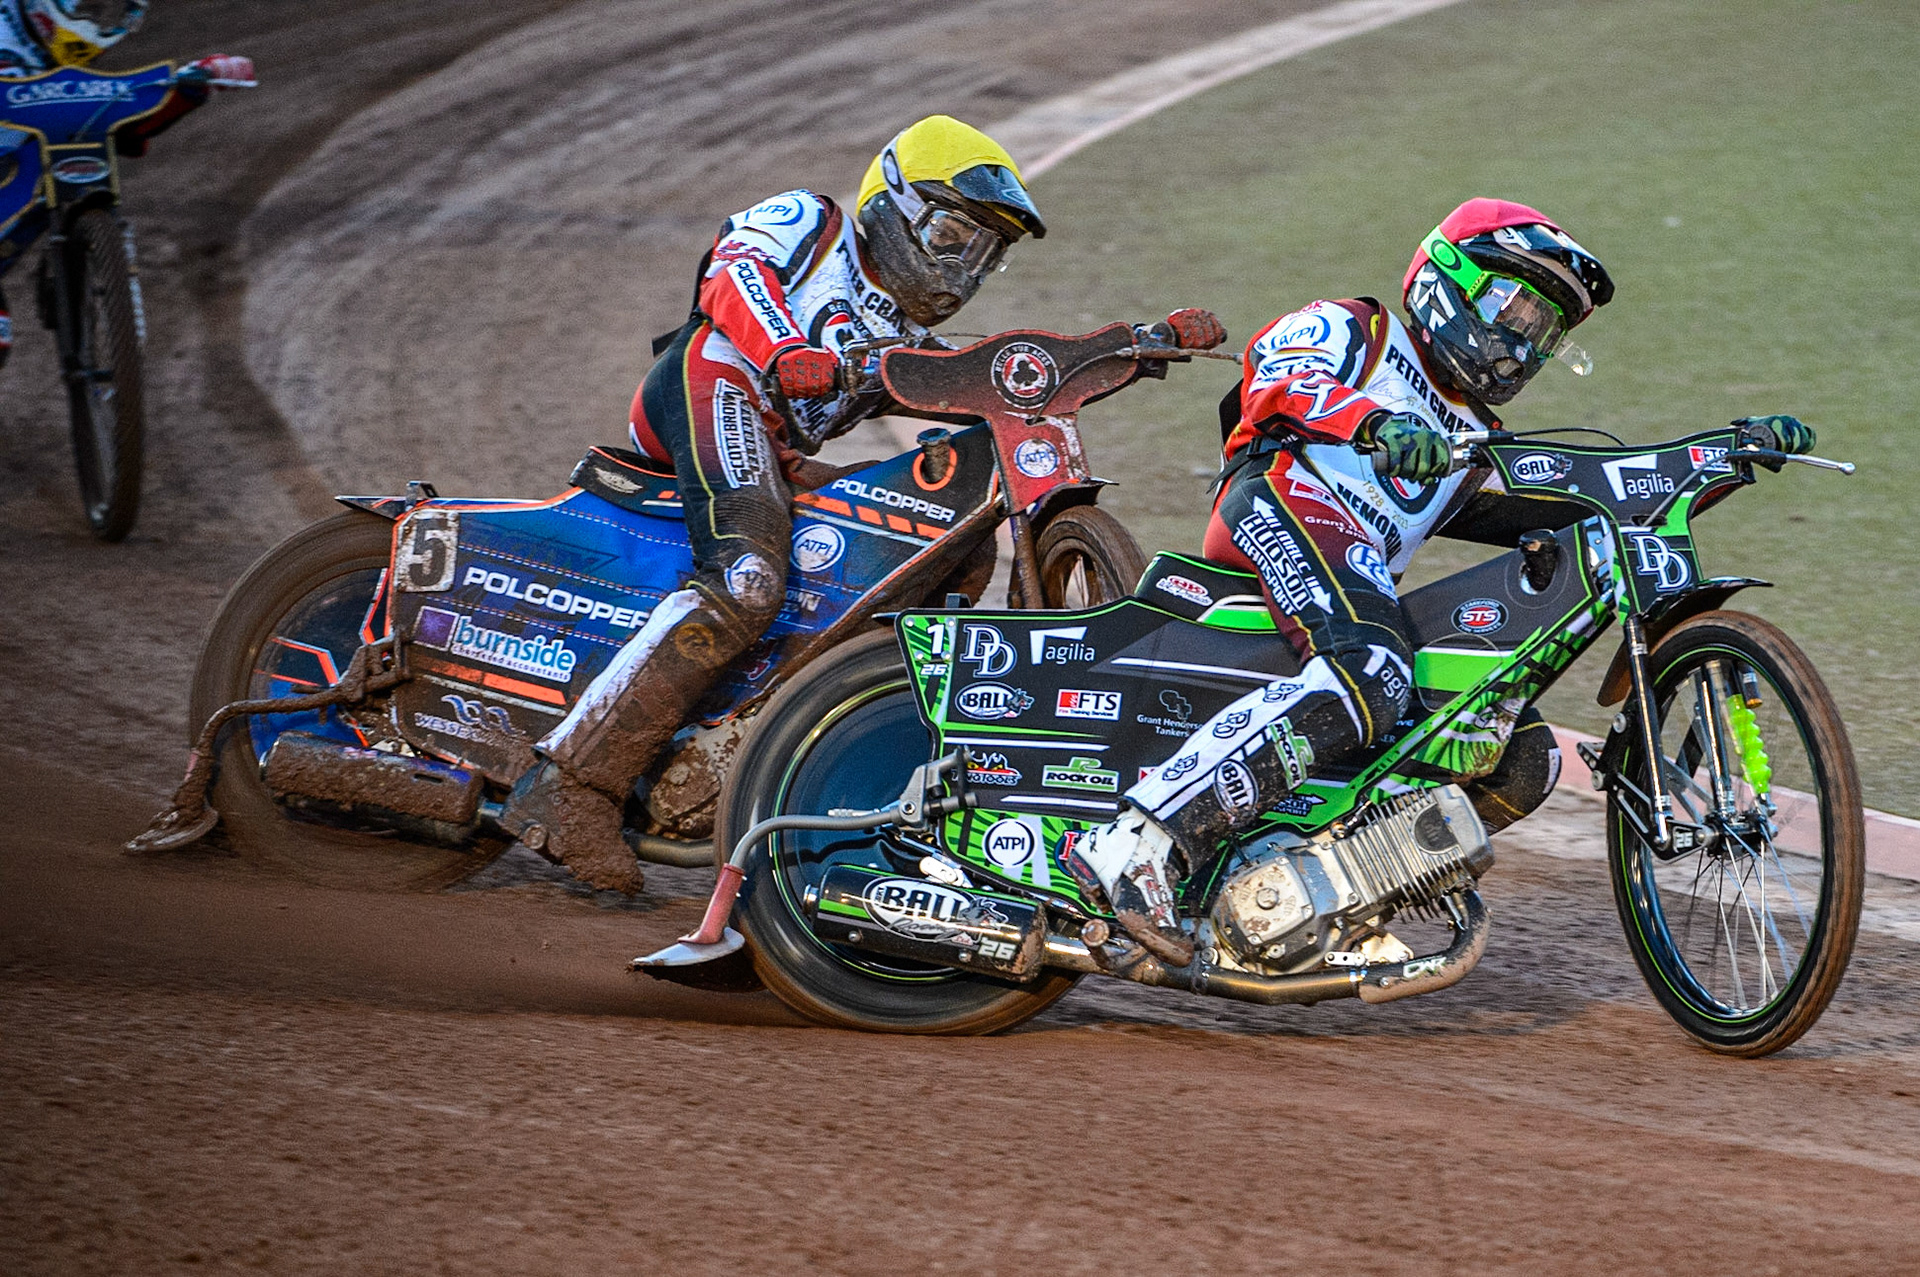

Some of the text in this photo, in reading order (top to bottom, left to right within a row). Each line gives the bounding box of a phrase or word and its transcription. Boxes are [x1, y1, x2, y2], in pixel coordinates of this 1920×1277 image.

[735, 261, 790, 338] POLCOPPER
[1385, 344, 1428, 400] PETER
[1626, 474, 1675, 498] agilia
[832, 478, 955, 522] POLCOPPER
[1304, 516, 1345, 529] Grant
[408, 514, 447, 587] 5
[797, 538, 833, 554] ATPI
[1462, 610, 1497, 622] STS
[456, 616, 575, 670] burnside
[927, 624, 944, 654] 1
[1045, 644, 1095, 665] agilia
[920, 664, 948, 675] 26
[1079, 692, 1118, 711] FTS
[1137, 715, 1161, 726] Grant
[1155, 726, 1190, 737] Tankers
[1046, 772, 1115, 786] ROCK OIL
[993, 837, 1025, 850] ATPI
[1676, 832, 1693, 848] 26
[979, 938, 1017, 961] 26
